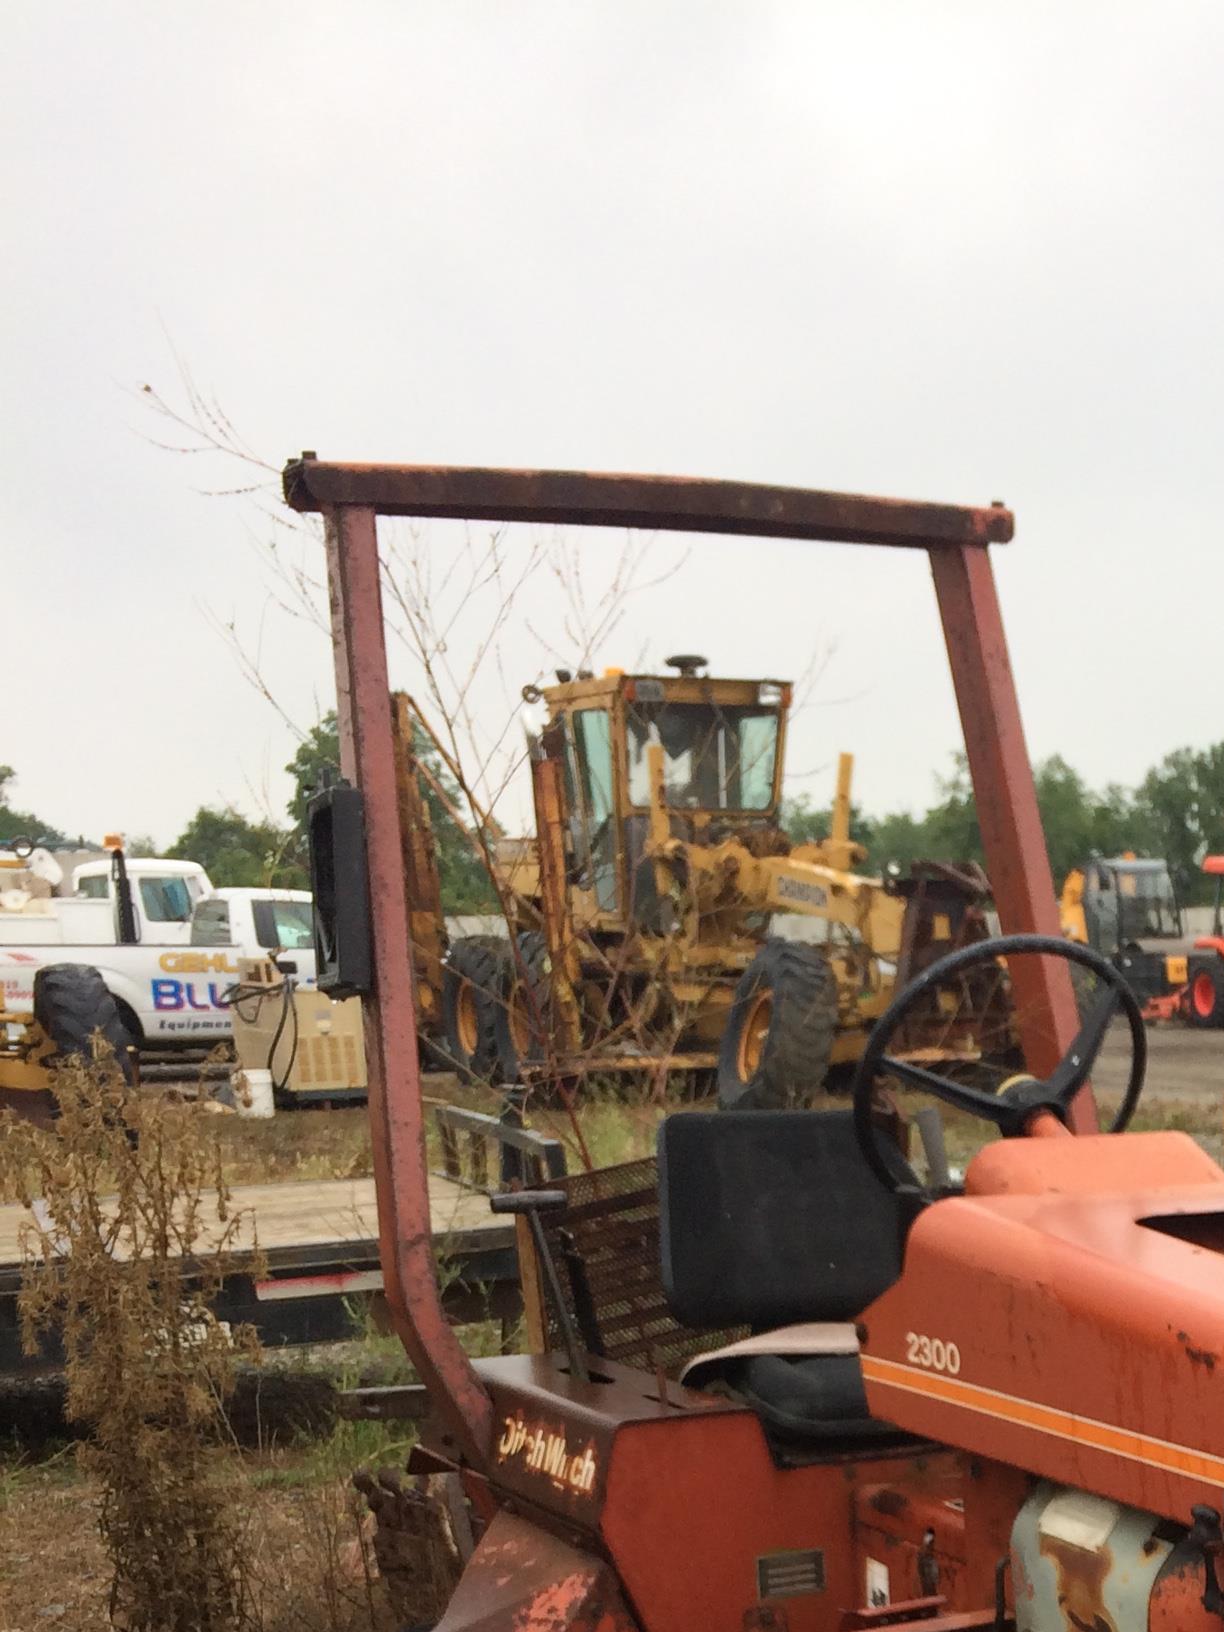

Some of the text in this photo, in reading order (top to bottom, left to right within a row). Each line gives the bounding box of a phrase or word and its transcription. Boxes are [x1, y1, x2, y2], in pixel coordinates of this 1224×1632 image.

[150, 978, 232, 1012] BLU
[158, 1019, 232, 1031] Equipmen
[905, 1331, 961, 1375] 2300
